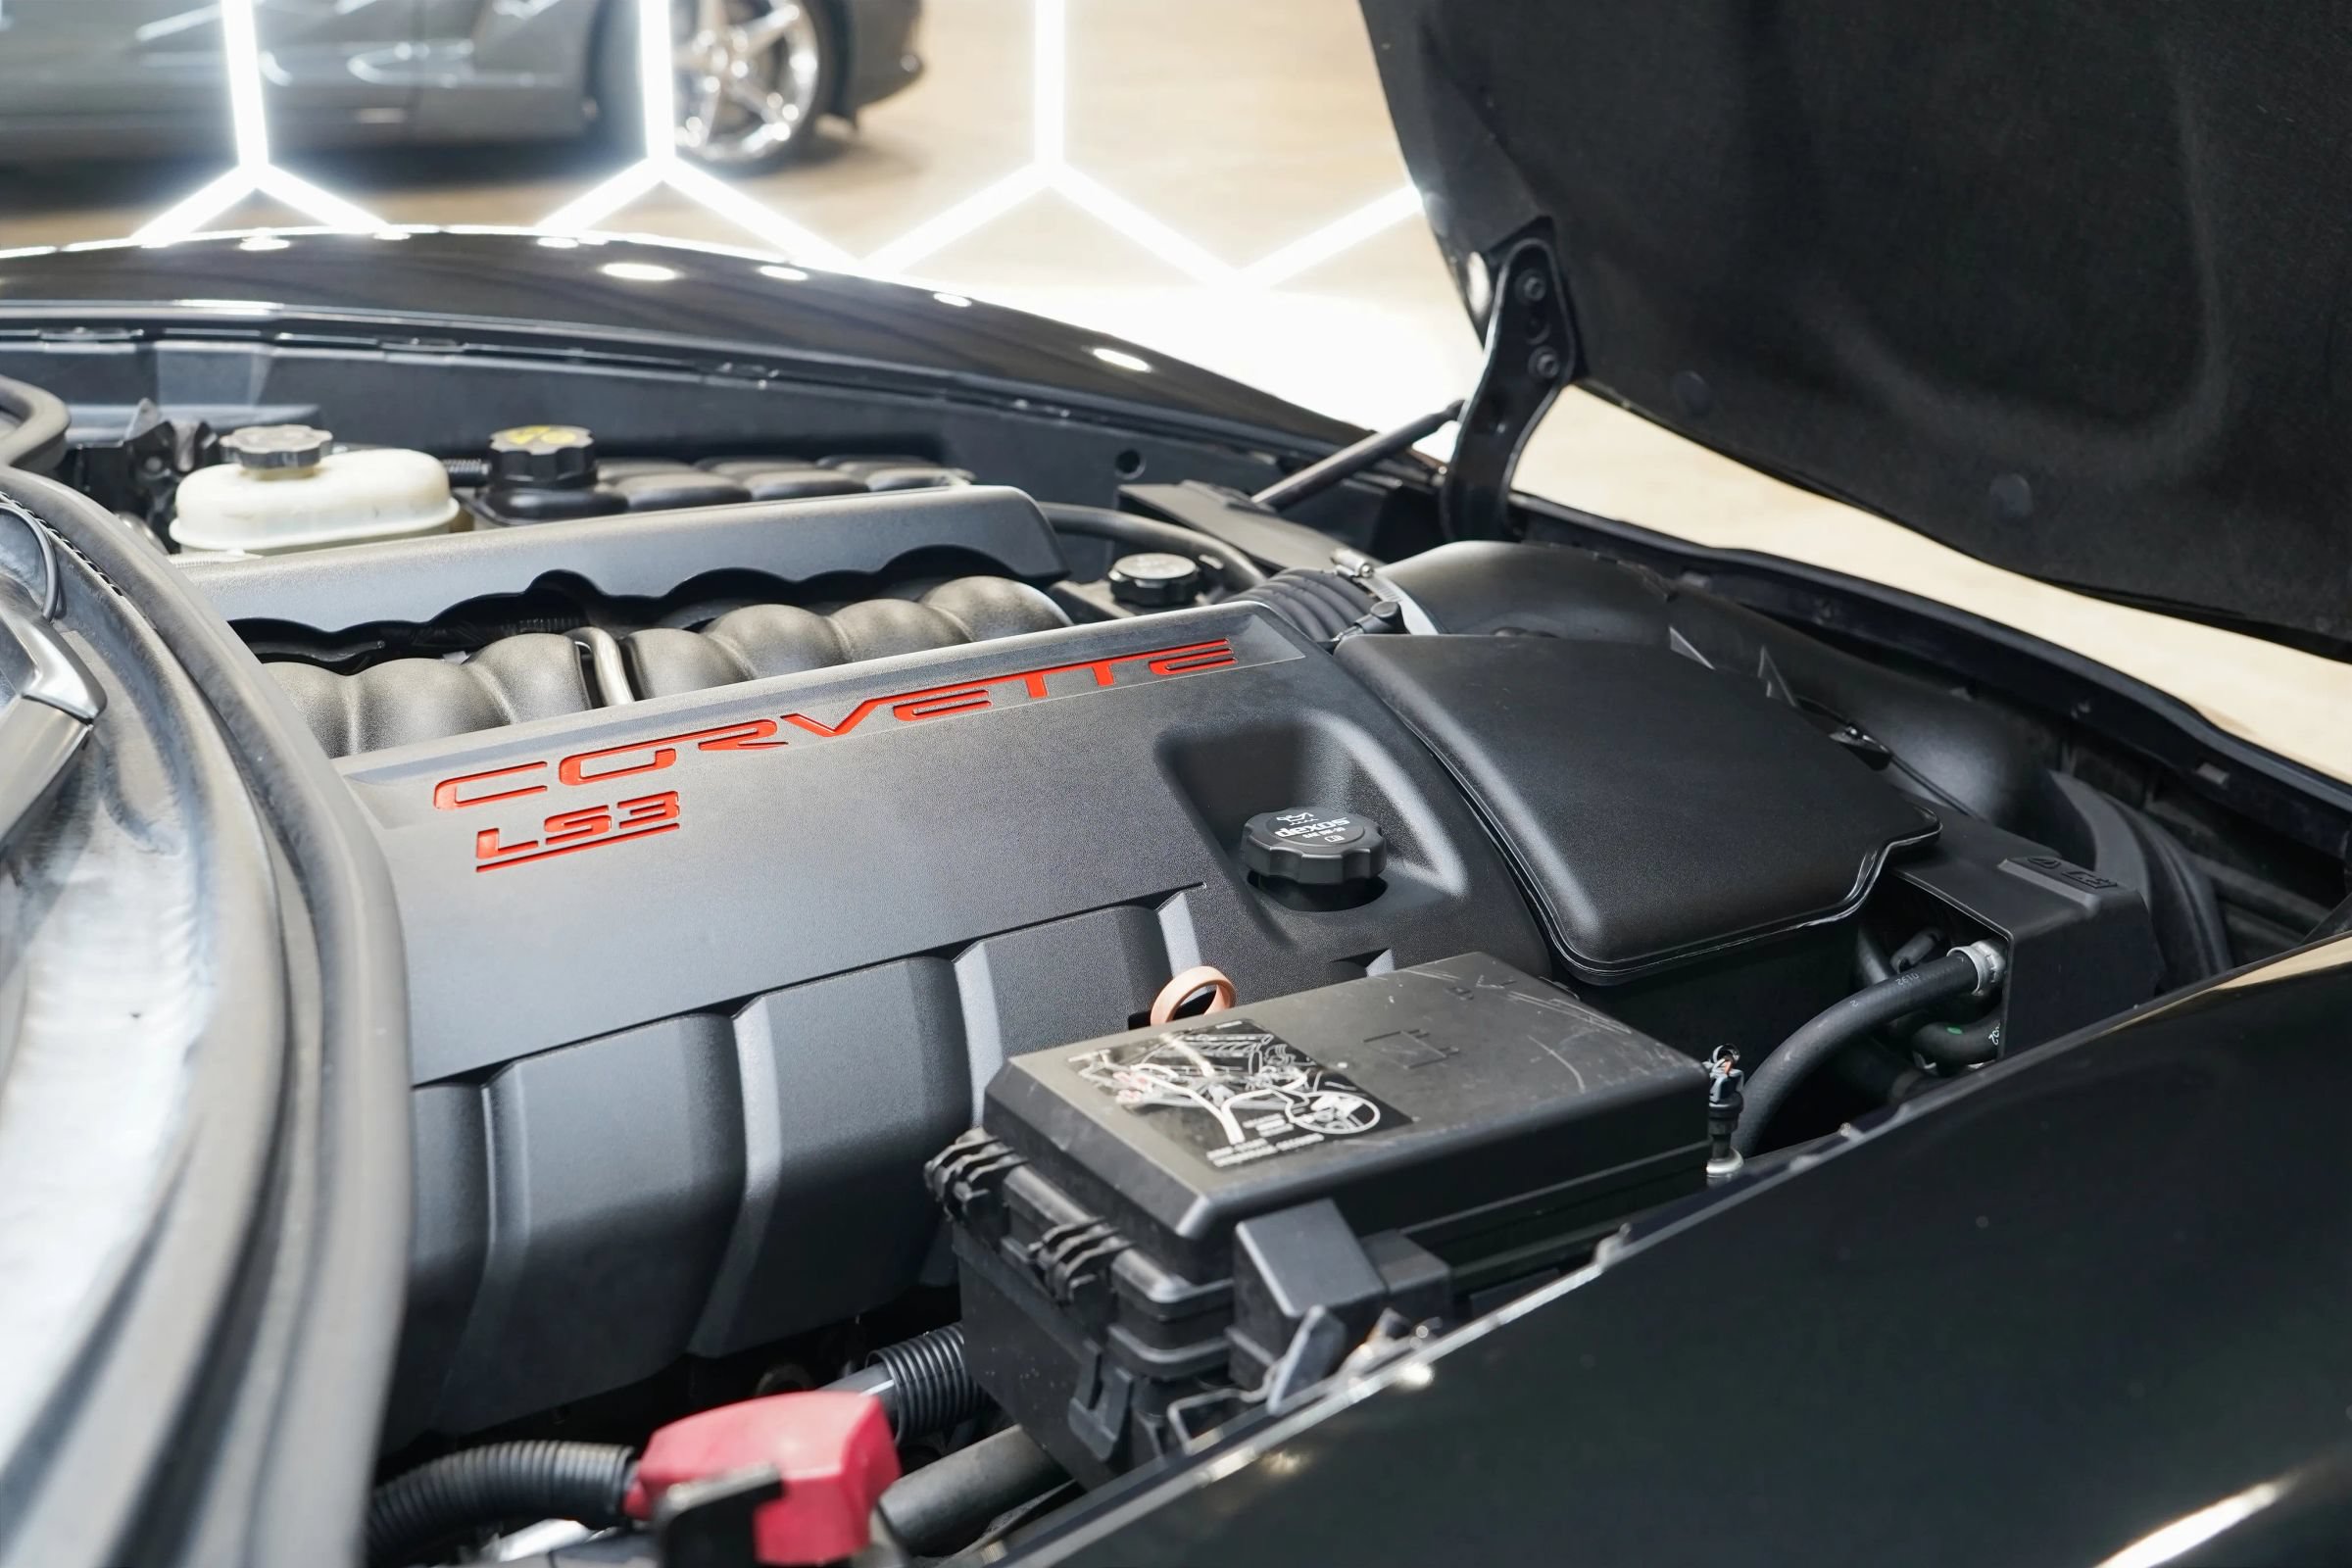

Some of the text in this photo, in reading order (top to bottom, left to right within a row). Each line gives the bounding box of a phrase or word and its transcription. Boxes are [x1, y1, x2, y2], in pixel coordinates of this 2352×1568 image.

[433, 639, 1237, 810] CORVETTE
[475, 790, 680, 860] LS3
[1274, 817, 1350, 837] dexos
